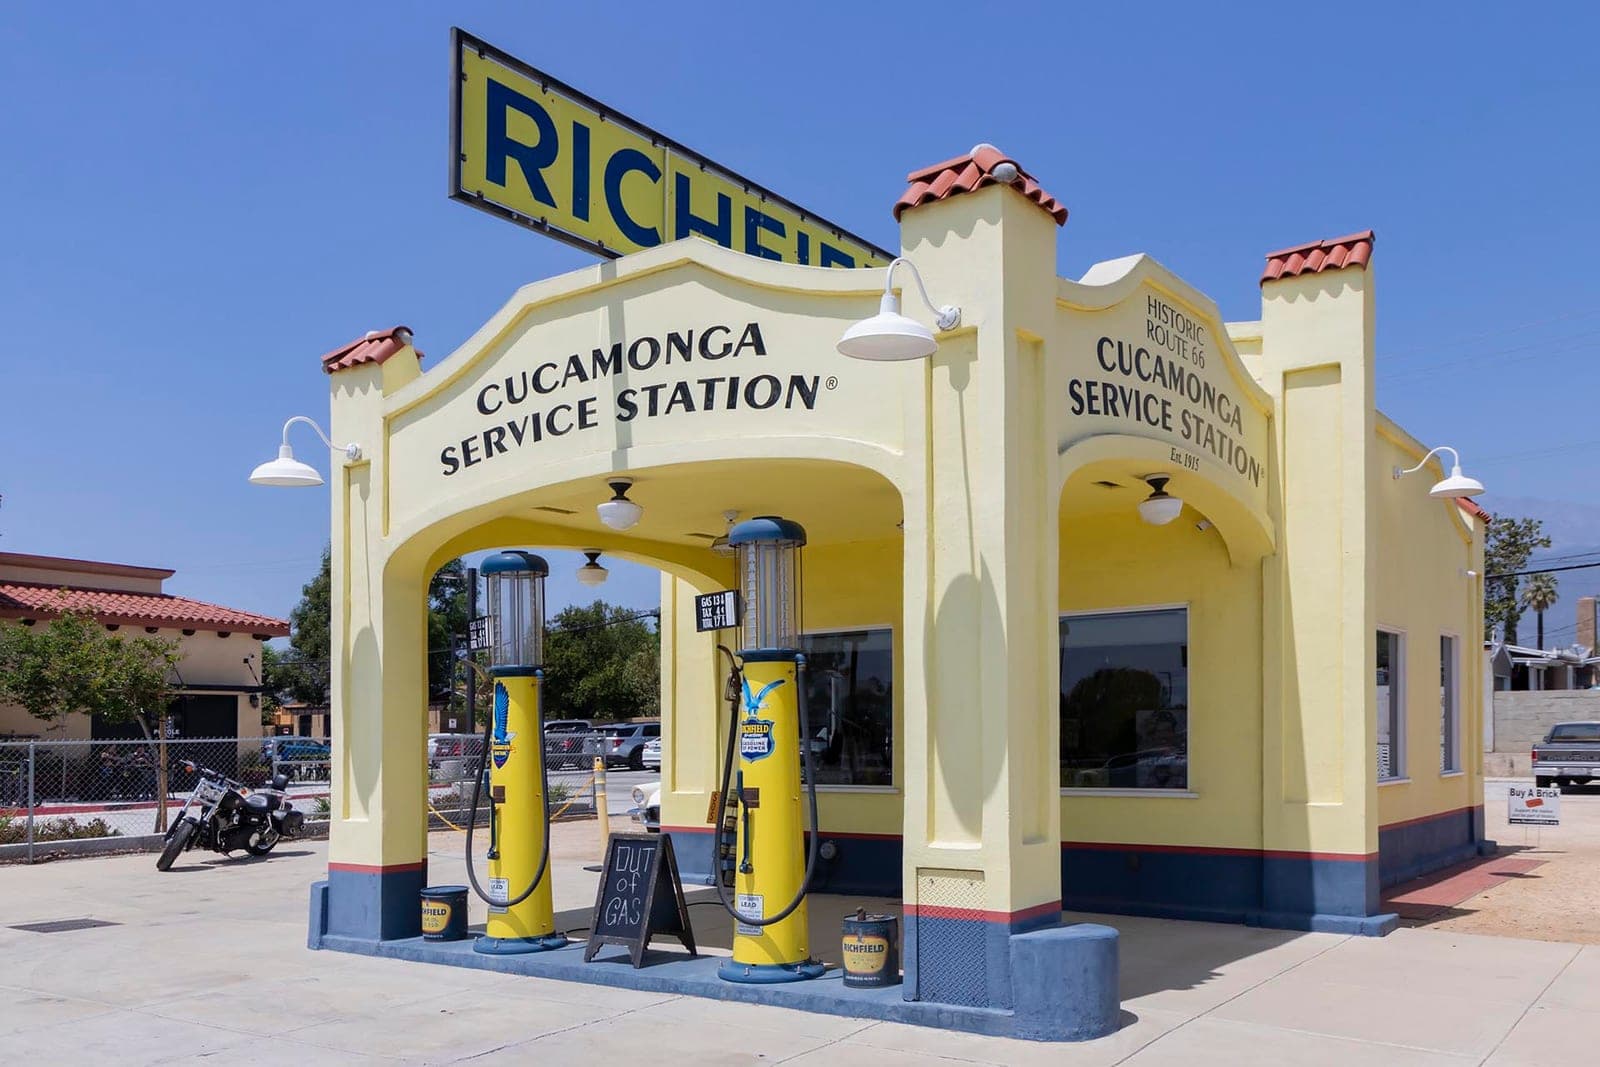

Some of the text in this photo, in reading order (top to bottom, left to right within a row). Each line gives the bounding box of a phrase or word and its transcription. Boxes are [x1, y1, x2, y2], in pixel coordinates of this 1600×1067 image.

[485, 77, 873, 269] RICHF
[1146, 295, 1205, 346] HISTORIC
[1146, 319, 1205, 369] ROUTE 66
[476, 322, 767, 416] CUCAMONGA
[1096, 336, 1243, 435] CUCAMONGA
[1068, 378, 1173, 432] SERVICE
[440, 397, 599, 476] SERVICE
[1183, 453, 1200, 472] 1915
[701, 596, 713, 607] GAS
[702, 607, 712, 618] TAX
[1510, 787, 1559, 799] Buy A Brick
[616, 846, 655, 873] OUT
[616, 871, 641, 894] of
[605, 896, 641, 926] GAS
[843, 943, 885, 953] RICHFIELD
